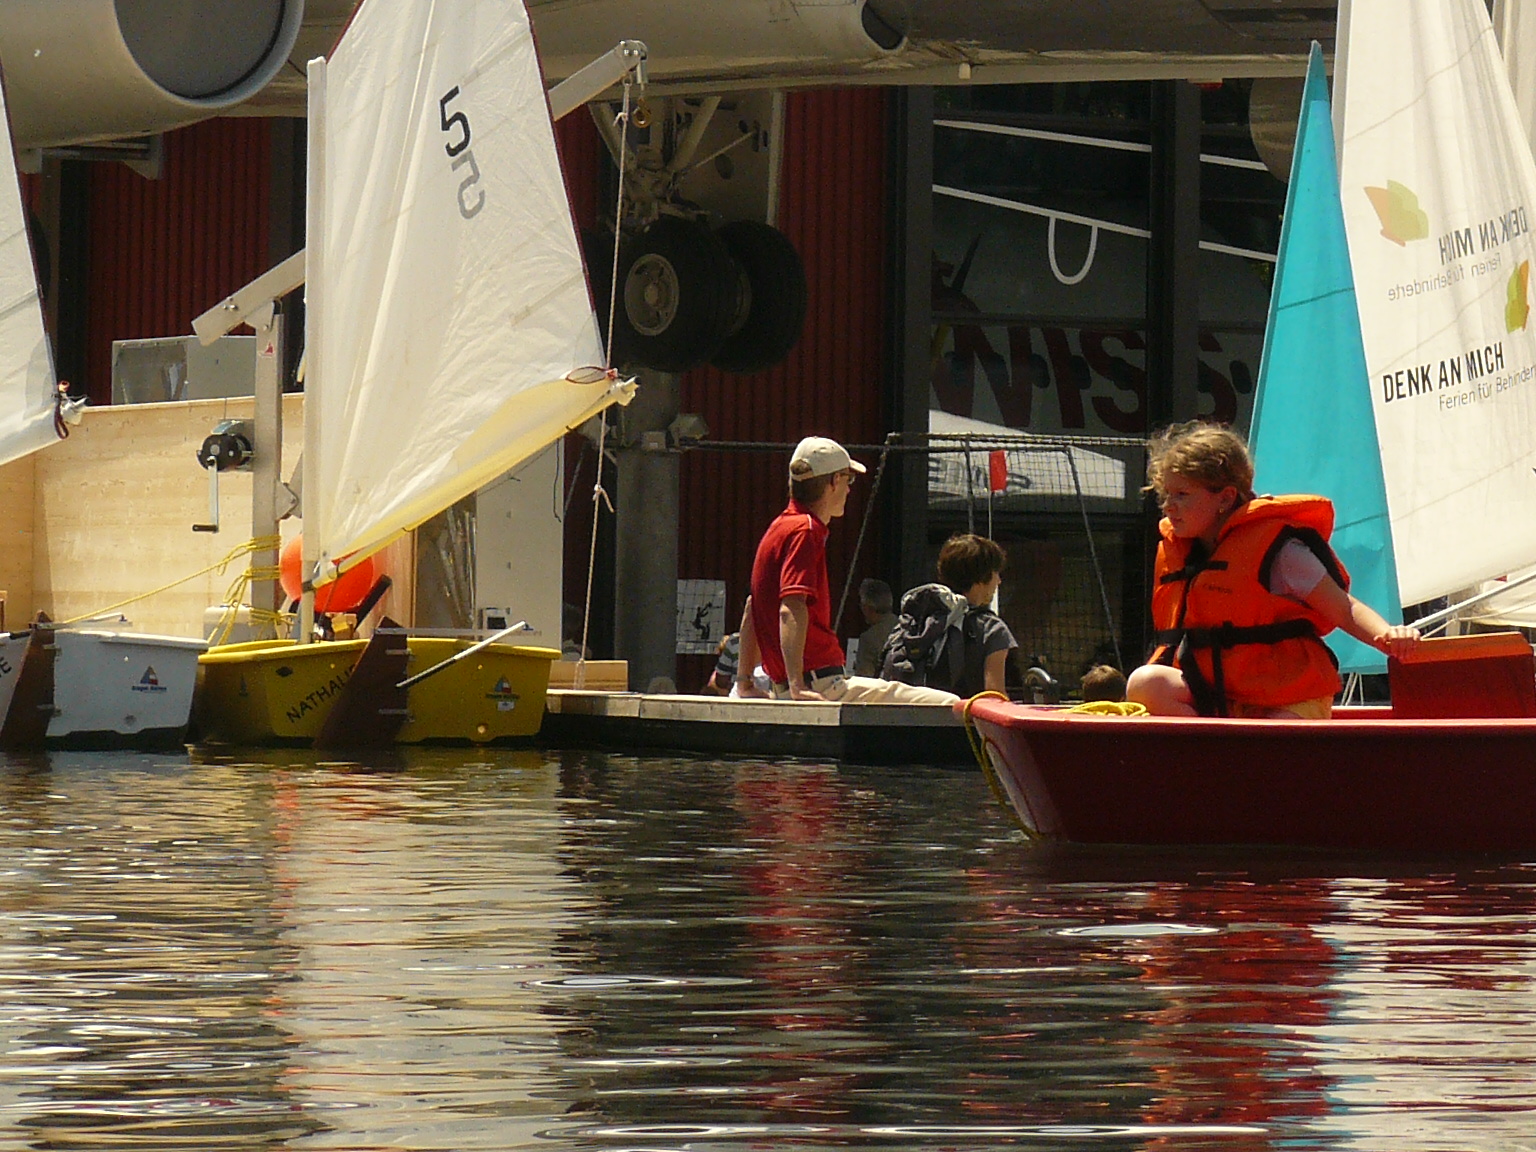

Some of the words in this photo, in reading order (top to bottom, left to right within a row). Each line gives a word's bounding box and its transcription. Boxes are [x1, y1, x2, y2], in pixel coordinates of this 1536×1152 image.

[439, 84, 471, 158] 5
[1382, 363, 1433, 403] DENK
[1437, 355, 1462, 390] AN
[1465, 341, 1505, 382] MICH
[1439, 390, 1476, 411] Ferien
[1477, 381, 1492, 400] für
